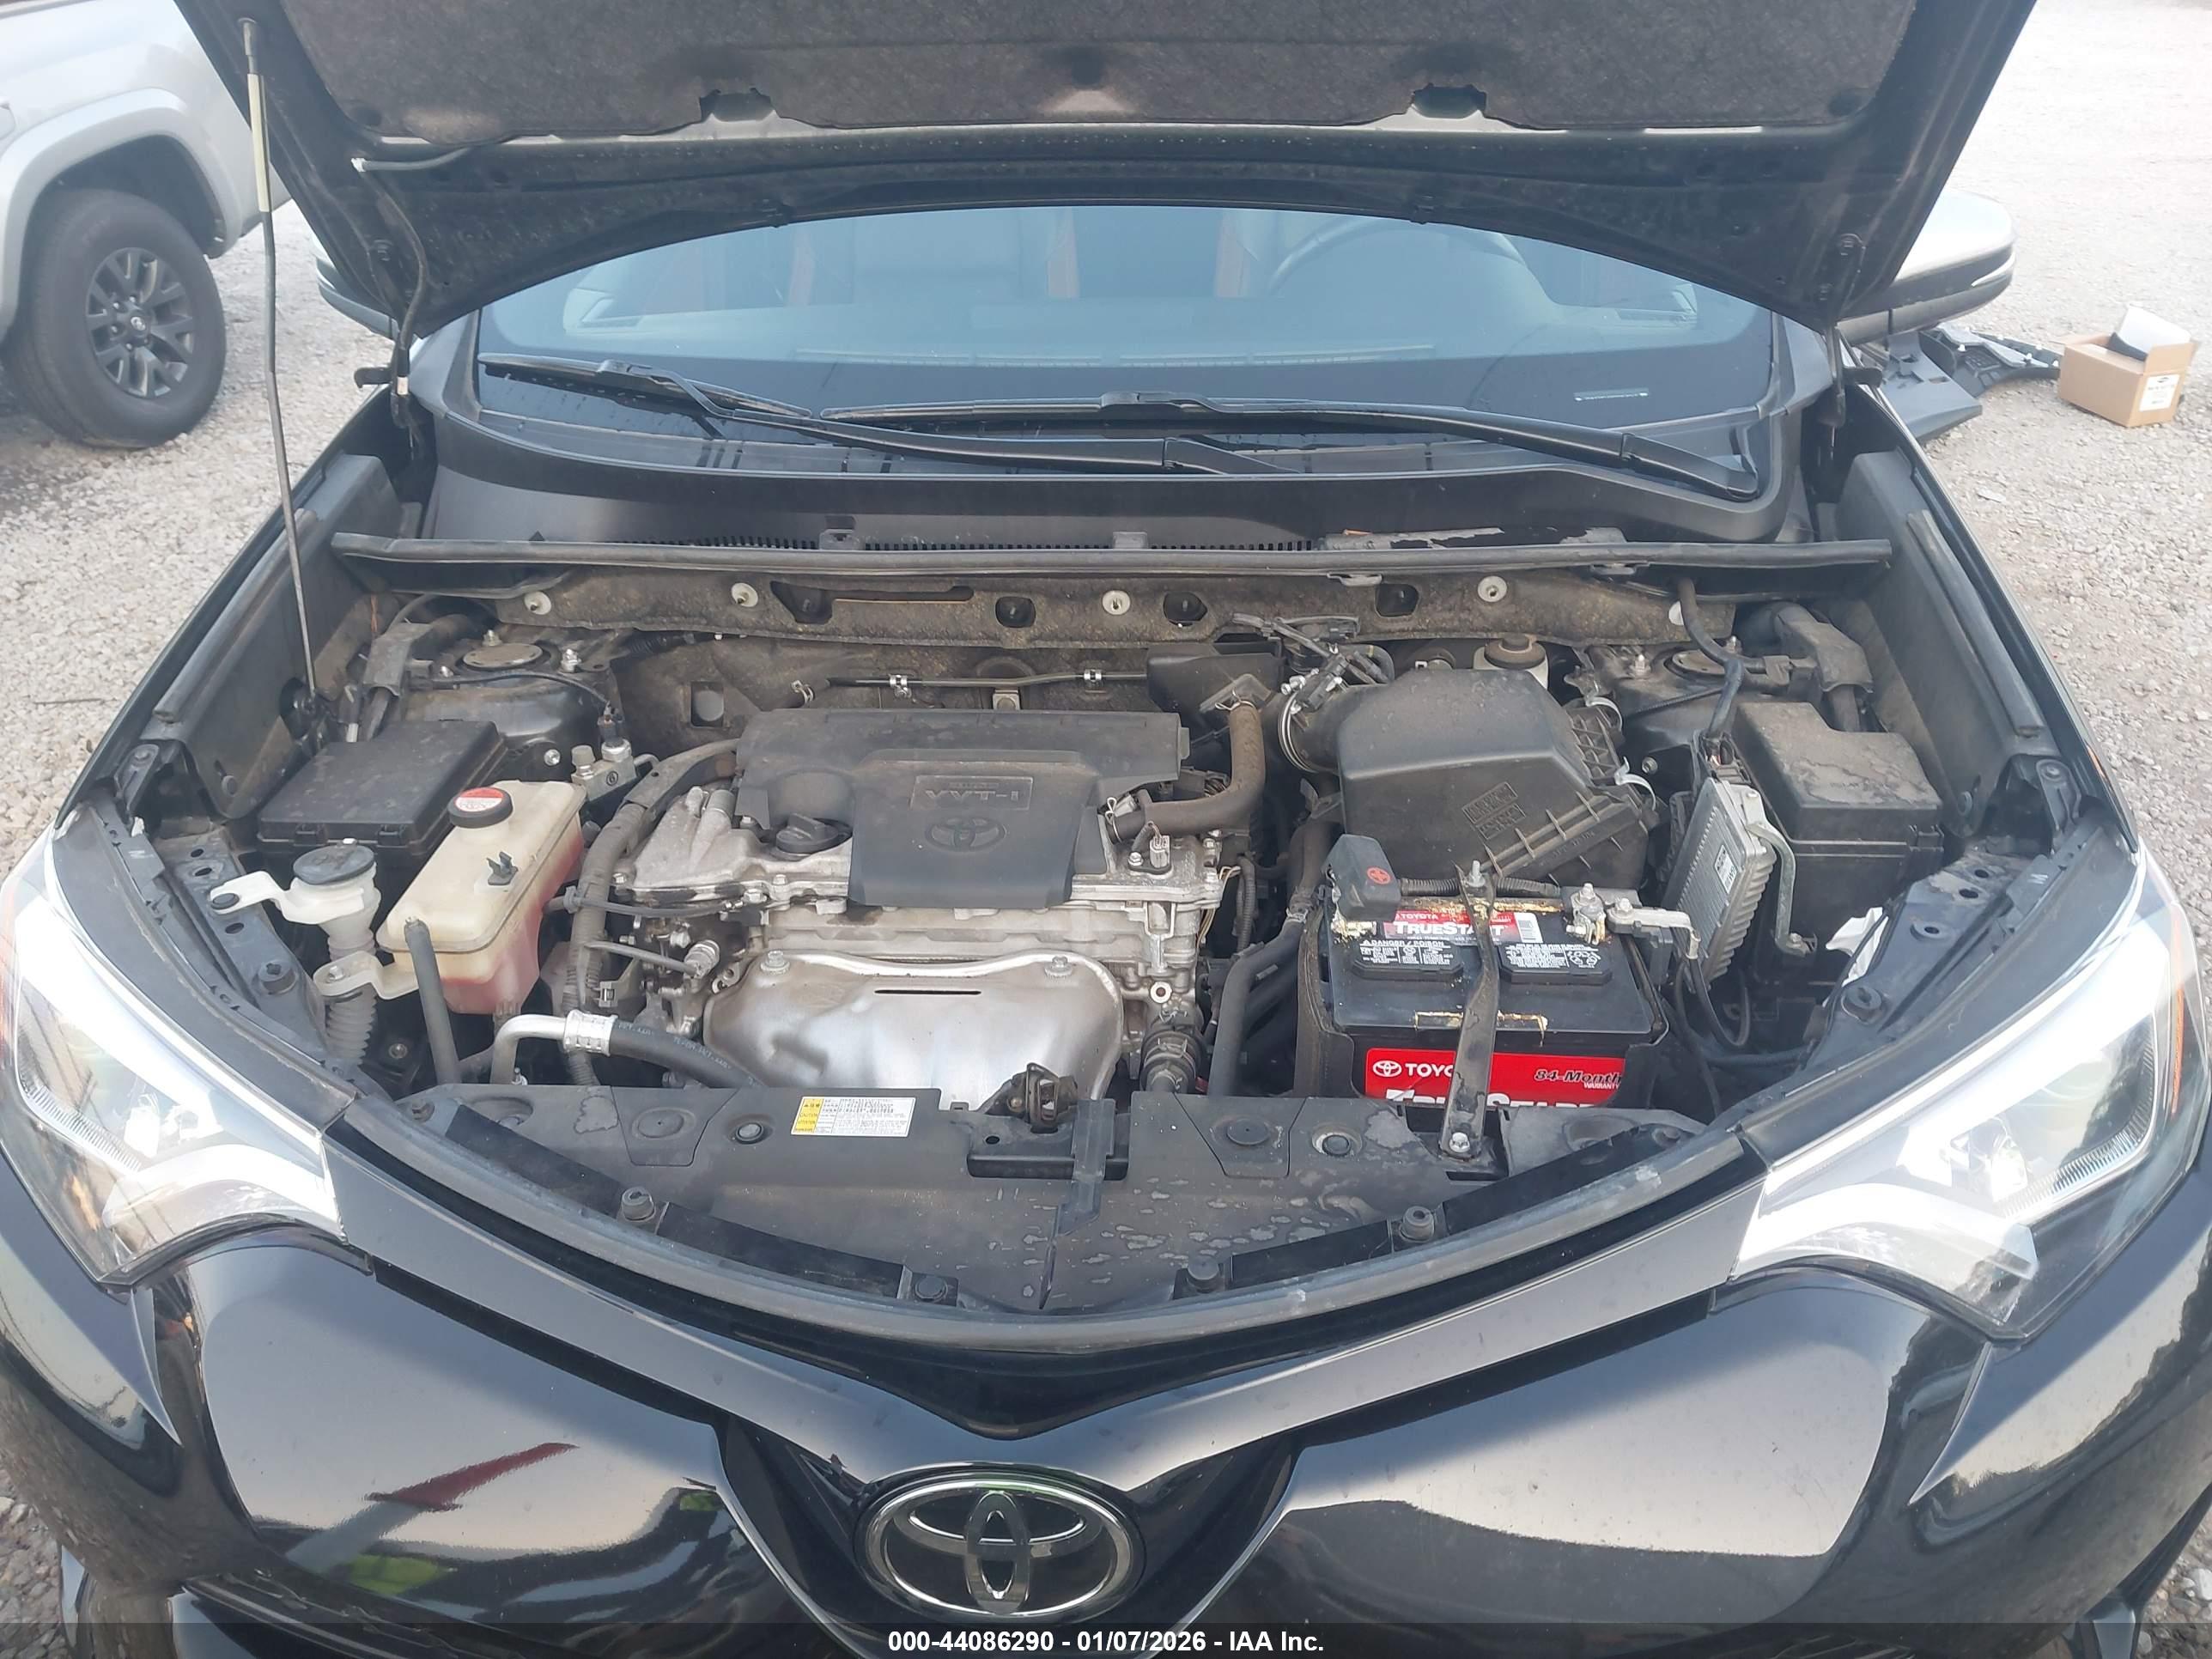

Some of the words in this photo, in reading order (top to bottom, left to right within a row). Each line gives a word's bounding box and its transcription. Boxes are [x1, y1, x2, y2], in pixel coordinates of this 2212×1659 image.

[1395, 921, 1504, 936] TRUESTAT
[1405, 1063, 1454, 1078] TOYO
[1534, 1068, 1622, 1082] 84-Month
